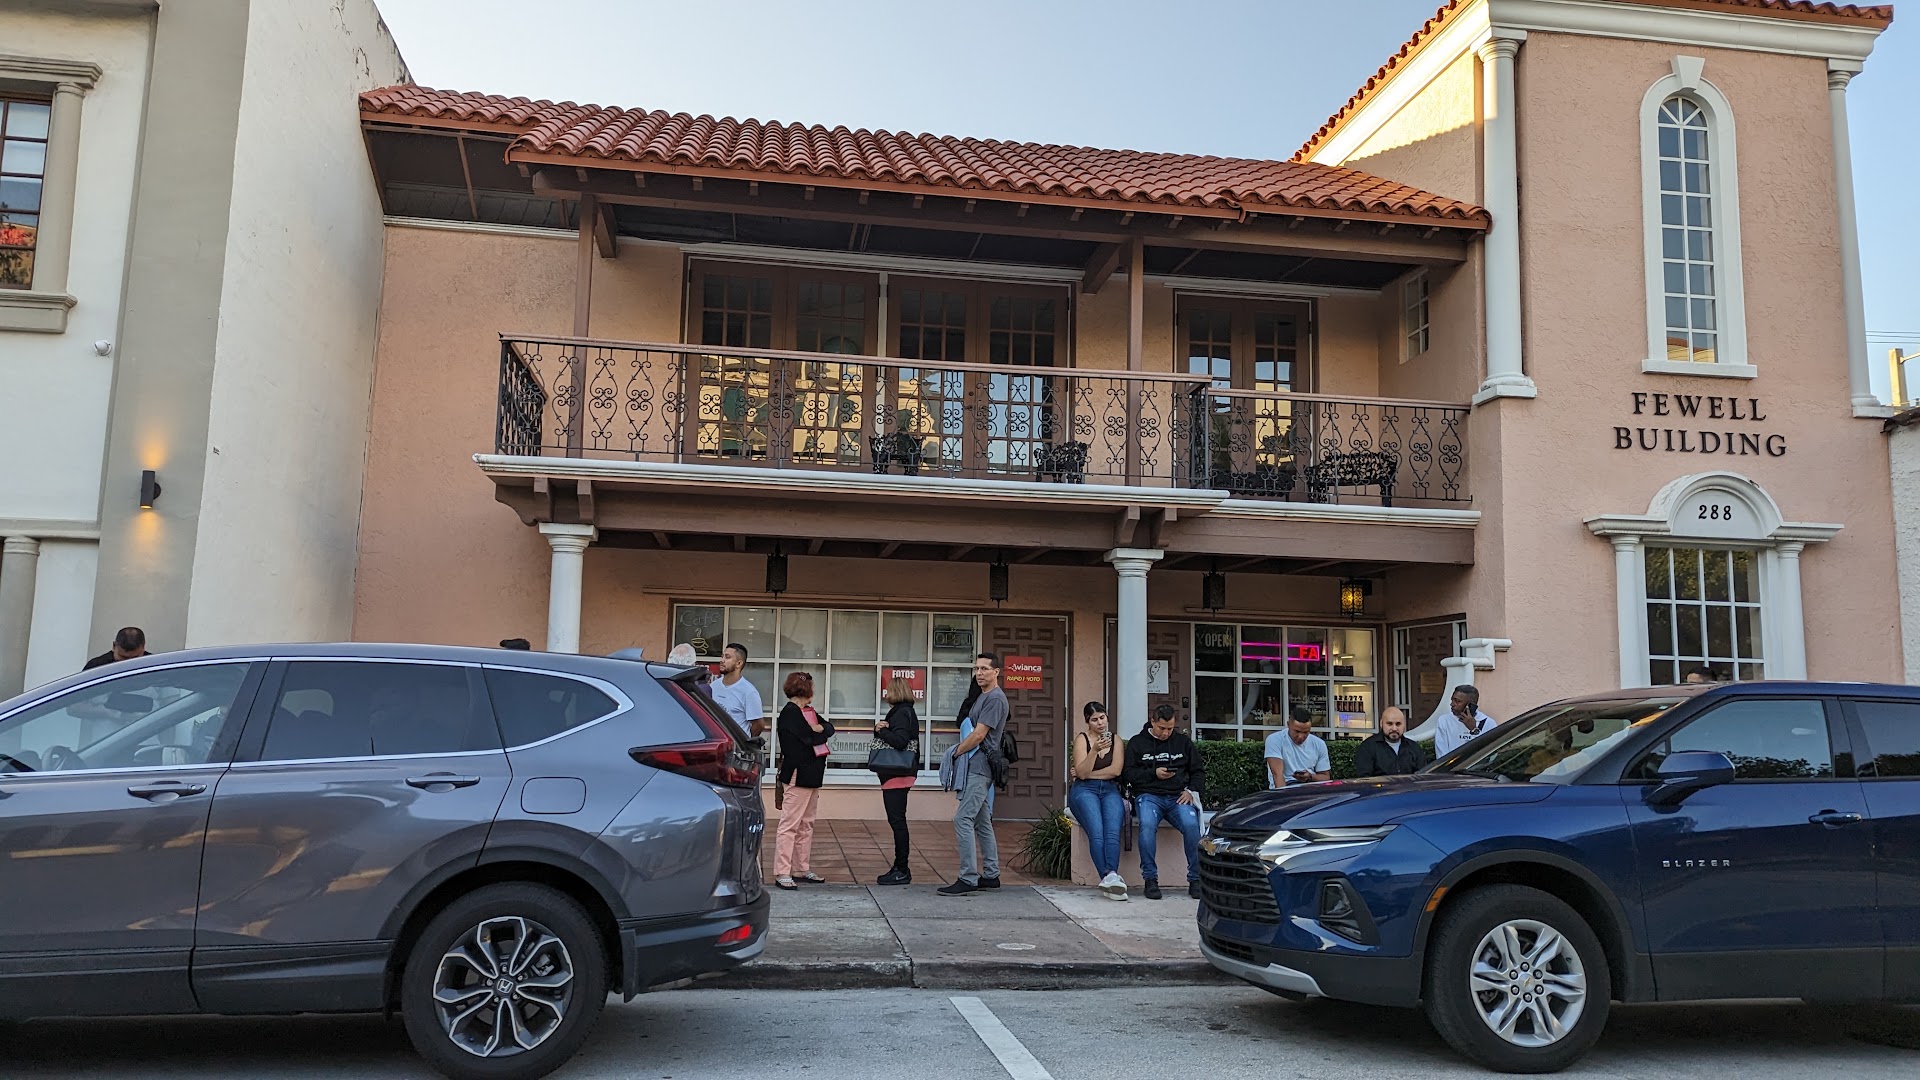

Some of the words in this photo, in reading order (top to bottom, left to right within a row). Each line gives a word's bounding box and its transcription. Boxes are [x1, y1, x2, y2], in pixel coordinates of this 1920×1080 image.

[1631, 392, 1767, 421] FEWELL
[1613, 426, 1787, 457] BUILDING
[1698, 505, 1732, 520] 288
[1204, 633, 1232, 648] OPEN
[892, 669, 915, 679] FOTOS
[1662, 859, 1730, 868] BLAZER
